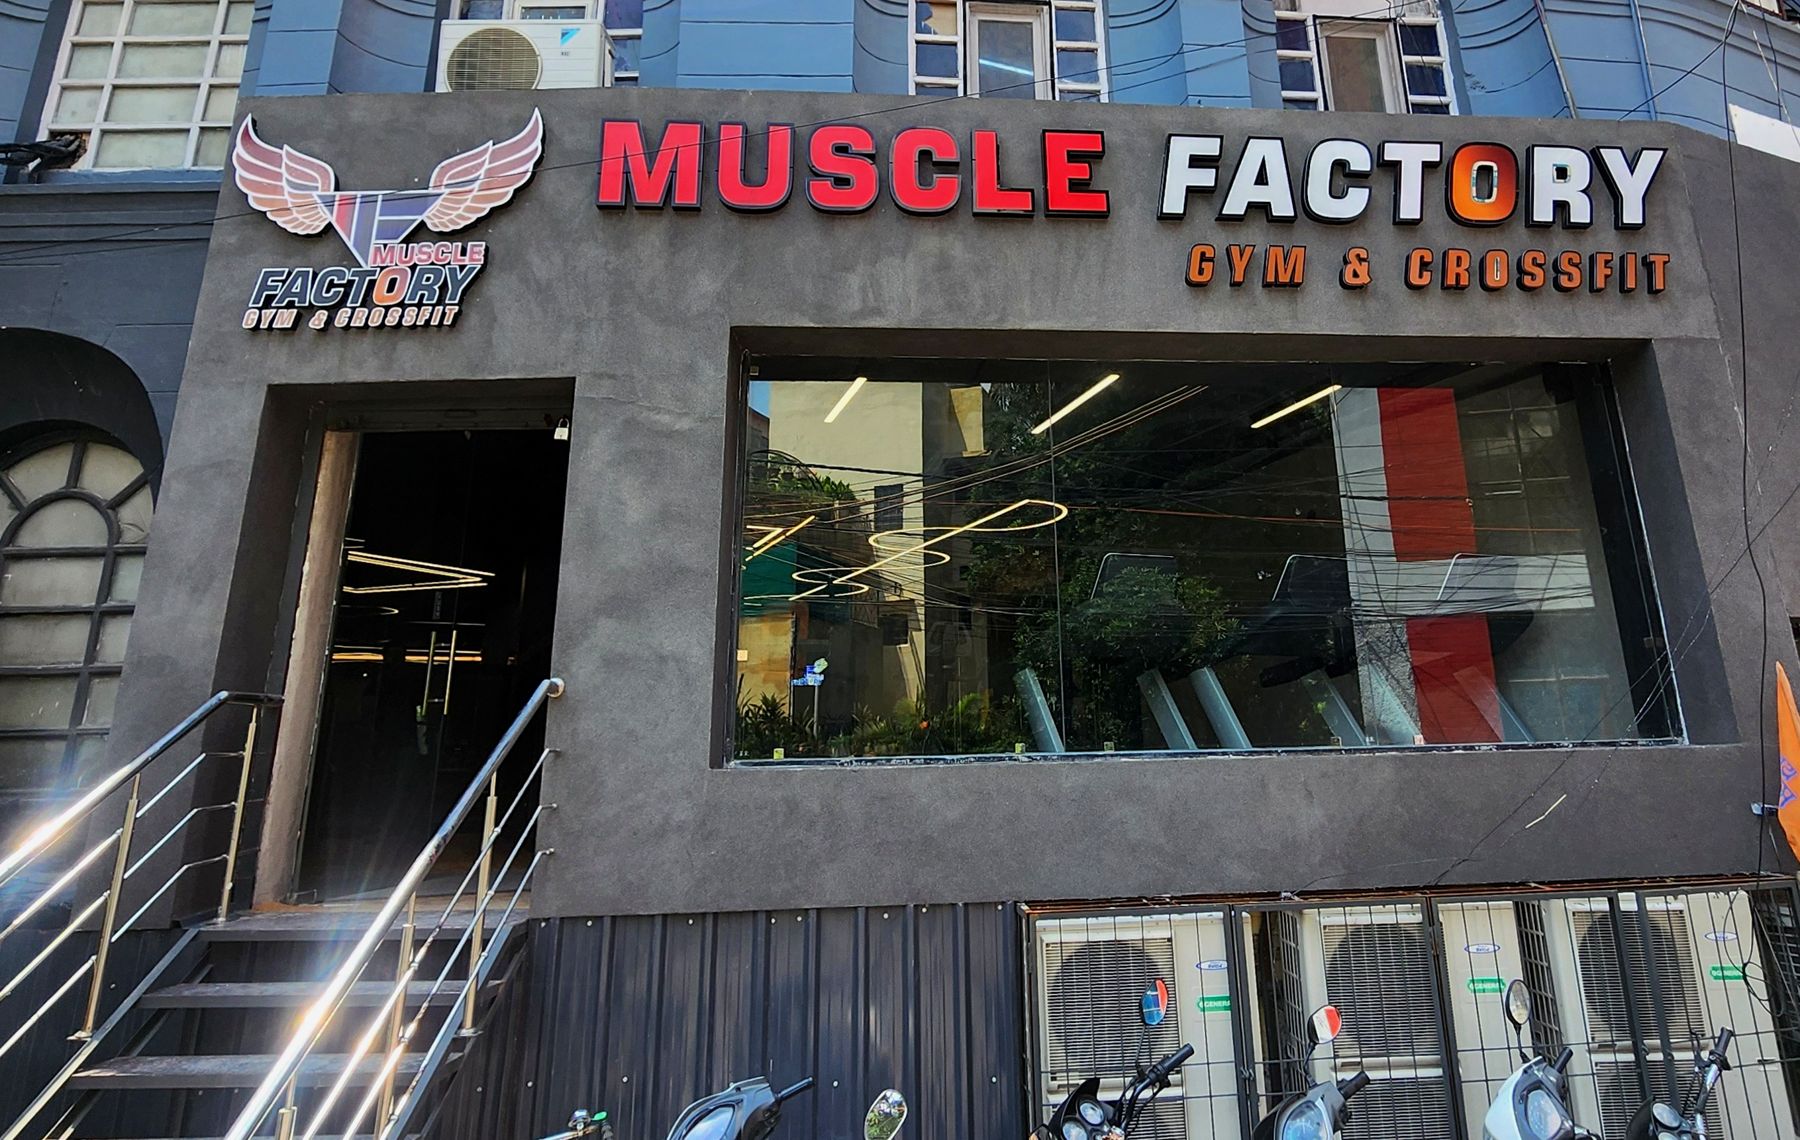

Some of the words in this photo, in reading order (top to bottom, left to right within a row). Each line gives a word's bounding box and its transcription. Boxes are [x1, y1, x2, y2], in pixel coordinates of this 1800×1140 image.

[597, 118, 1110, 217] MUSCLE
[1157, 133, 1669, 230] FACTORY
[369, 242, 487, 266] MUSCLE
[1185, 244, 1306, 288] GYM
[1340, 247, 1372, 292] &
[1405, 247, 1671, 294] CROSSFIT
[249, 265, 481, 307] FACTORY
[241, 307, 298, 329] GYM
[308, 308, 329, 329] &
[334, 305, 460, 328] CROSSFIT
